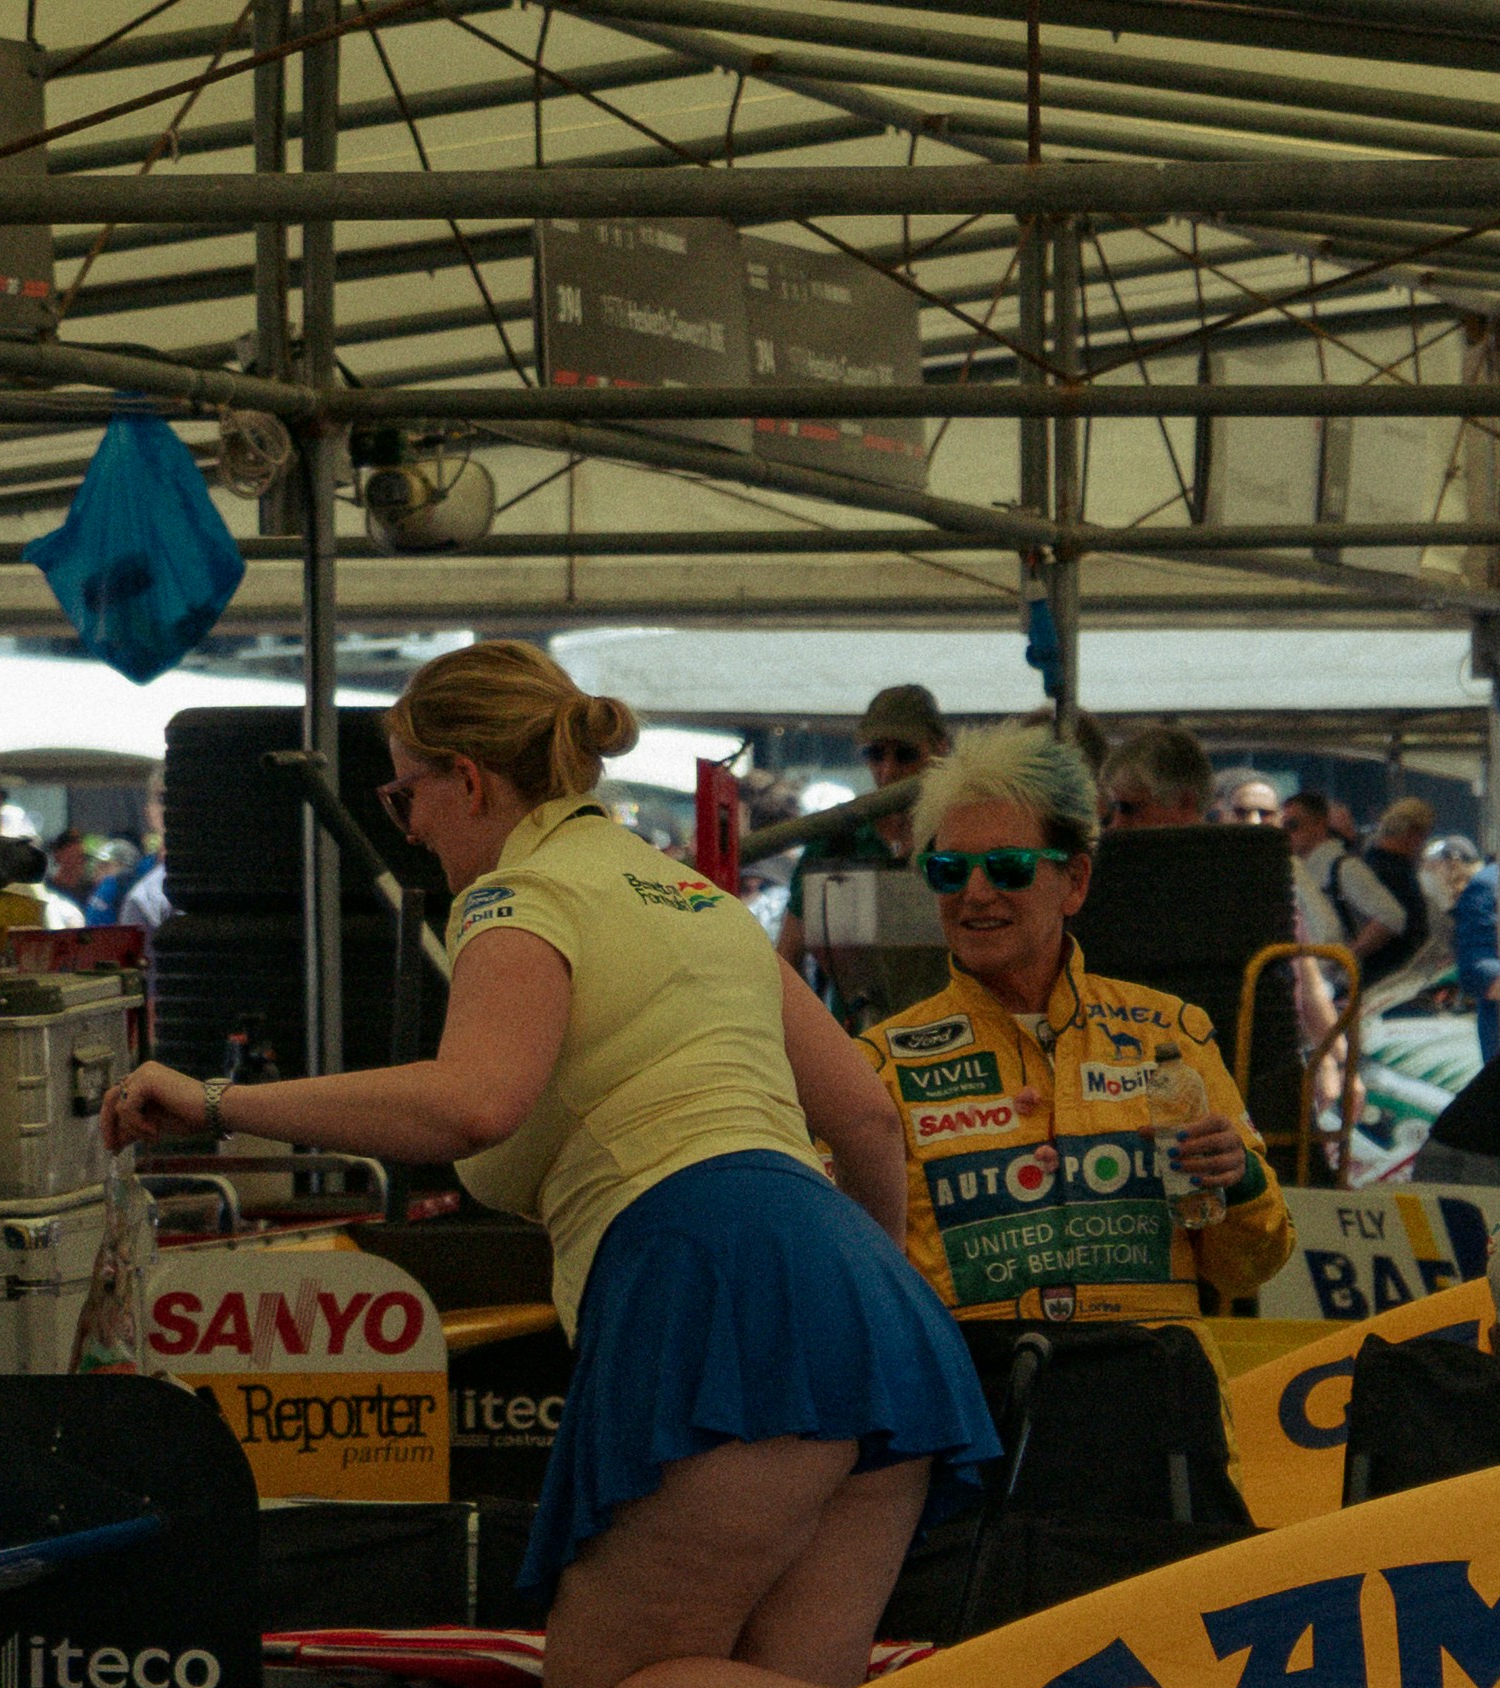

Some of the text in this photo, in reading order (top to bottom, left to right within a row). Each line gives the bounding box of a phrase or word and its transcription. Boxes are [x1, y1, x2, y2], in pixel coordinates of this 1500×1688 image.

[909, 1060, 990, 1089] VIVIL
[1087, 1067, 1150, 1096] Mobil
[918, 1105, 1013, 1137] SANYO
[936, 1142, 1164, 1208] AUTOPOLI
[963, 1214, 1161, 1259] UNITED COLORS
[1336, 1207, 1385, 1241] FLY
[985, 1261, 1018, 1284] OF
[147, 1284, 425, 1363] SANYO
[237, 1382, 438, 1454] Reporter
[462, 1388, 566, 1430] itec
[341, 1441, 436, 1470] parfum
